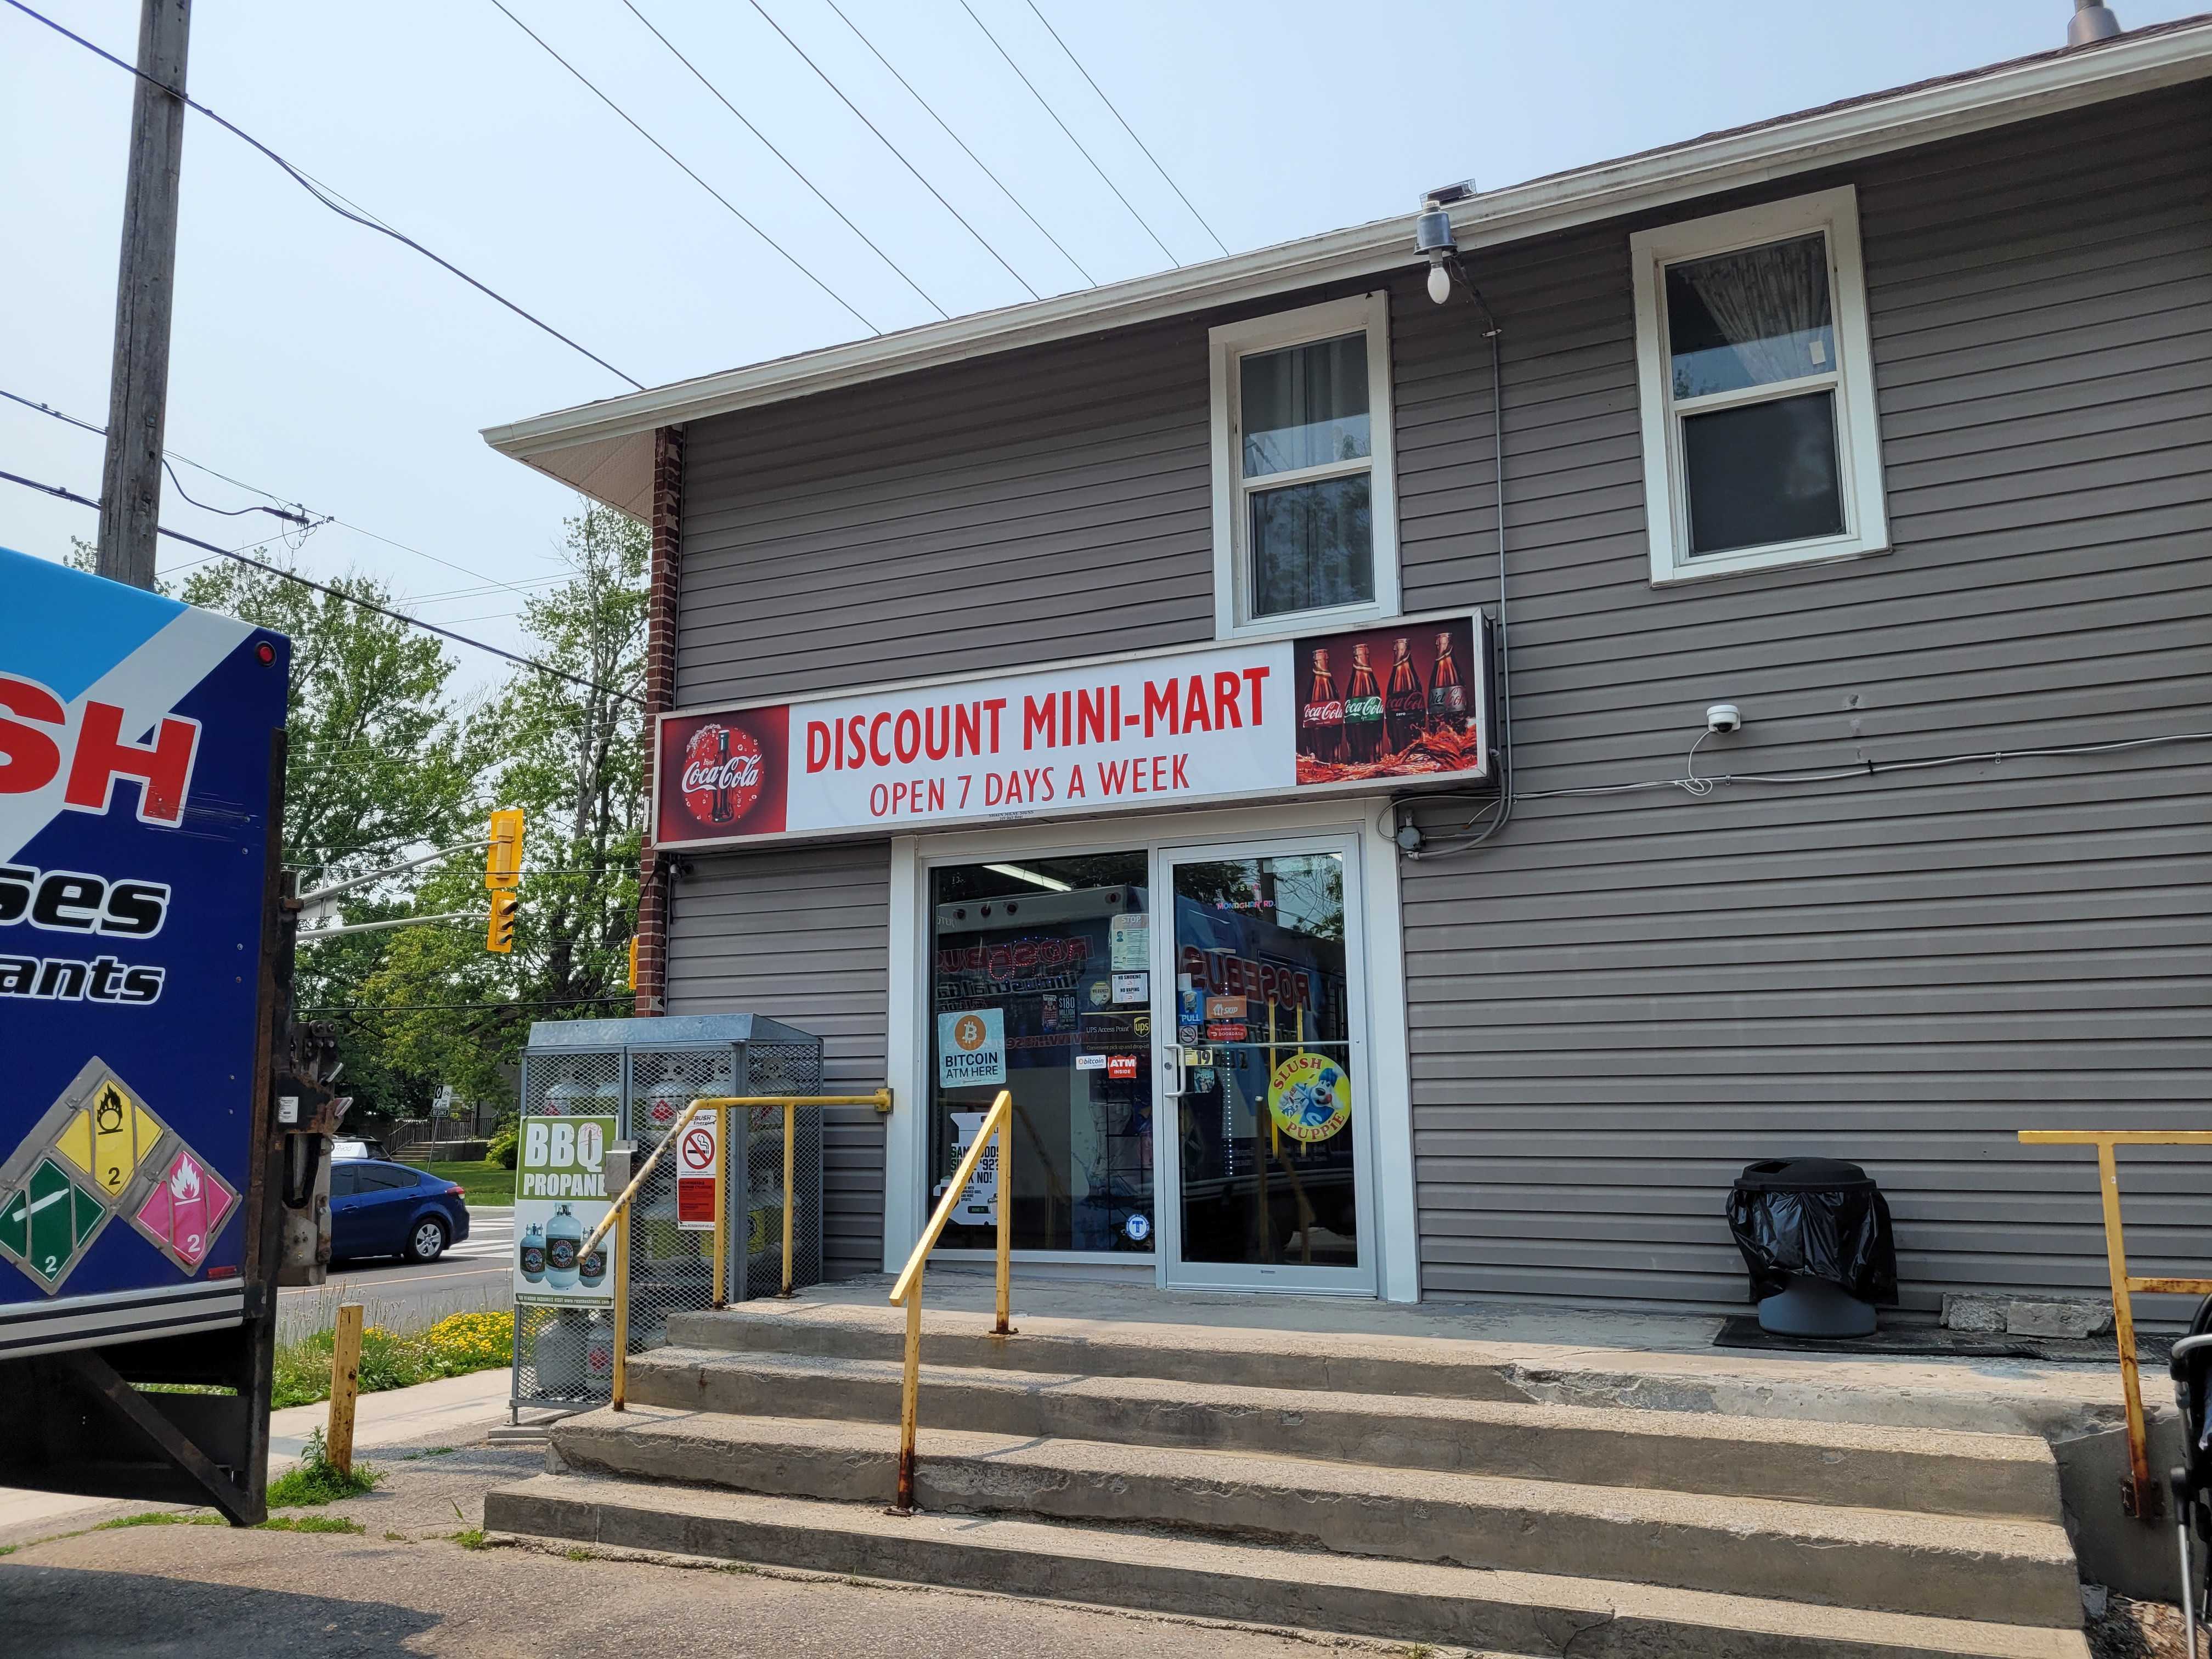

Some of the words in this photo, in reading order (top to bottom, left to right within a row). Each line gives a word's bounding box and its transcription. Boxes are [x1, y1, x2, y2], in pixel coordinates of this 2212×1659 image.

[806, 698, 1007, 774] DISCOUNT
[1023, 667, 1269, 751] MINI-MART
[682, 754, 762, 793] Coca-Cola
[871, 779, 944, 816] OPEN
[958, 775, 972, 809] 7
[985, 767, 1054, 806] DAYS
[1068, 765, 1086, 798] A
[1098, 754, 1189, 795] WEEK
[1059, 996, 1075, 1009] $180
[1223, 1006, 1238, 1014] SKIP
[1181, 1014, 1200, 1022] PULL
[1135, 1023, 1149, 1035] ups
[945, 1052, 997, 1067] BITCOIN
[1110, 1059, 1135, 1067] ATM
[1196, 1051, 1211, 1065] 19
[946, 1067, 968, 1079] ATM
[972, 1065, 998, 1076] HERE
[1273, 1057, 1322, 1090] SLUSH
[524, 1122, 603, 1172] BBQ
[108, 1166, 121, 1186] 2
[977, 1171, 992, 1183] NO!
[1132, 1220, 1143, 1233] T
[187, 1234, 201, 1253] 2
[44, 1255, 57, 1273] 2
